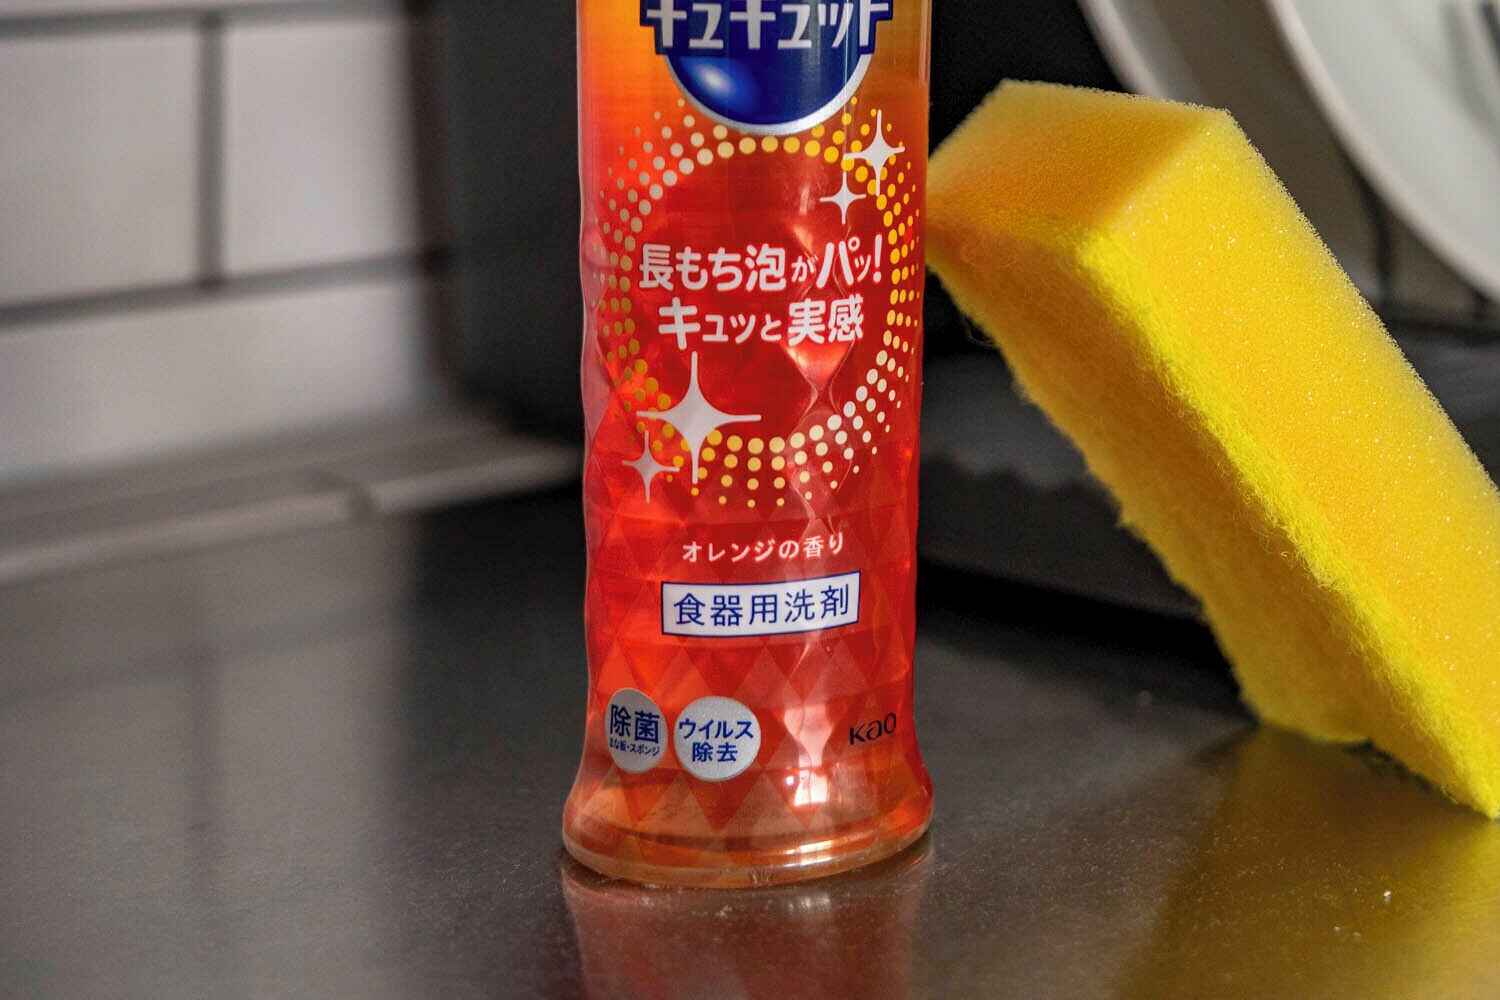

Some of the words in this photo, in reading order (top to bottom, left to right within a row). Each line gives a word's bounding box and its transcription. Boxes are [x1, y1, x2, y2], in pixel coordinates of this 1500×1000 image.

[658, 293, 864, 350] キュッと実感
[682, 533, 844, 563] オレンジの香り
[673, 584, 850, 627] 食器用洗剤
[609, 704, 660, 744] 除菌
[679, 718, 754, 740] ウイルス
[691, 741, 738, 762] 除去
